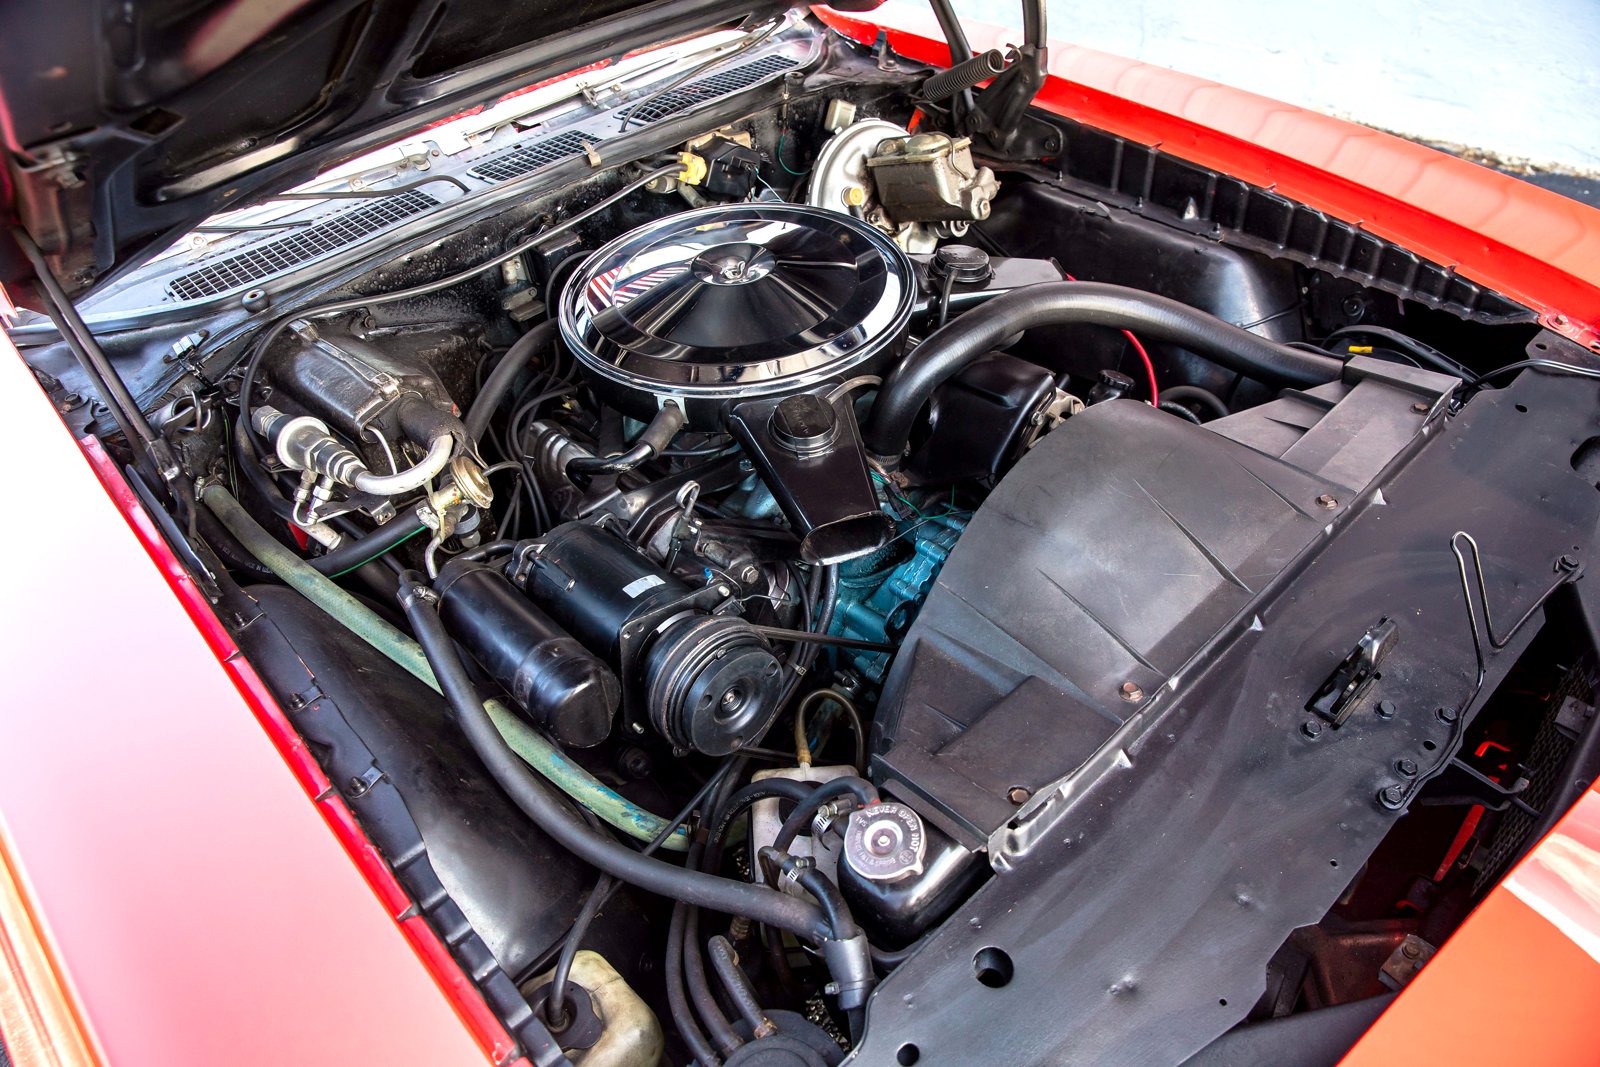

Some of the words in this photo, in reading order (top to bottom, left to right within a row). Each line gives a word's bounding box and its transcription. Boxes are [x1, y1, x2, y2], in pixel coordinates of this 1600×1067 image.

[866, 805, 898, 817] NEVER
[898, 809, 918, 831] OPEN
[909, 832, 920, 852] HOT
